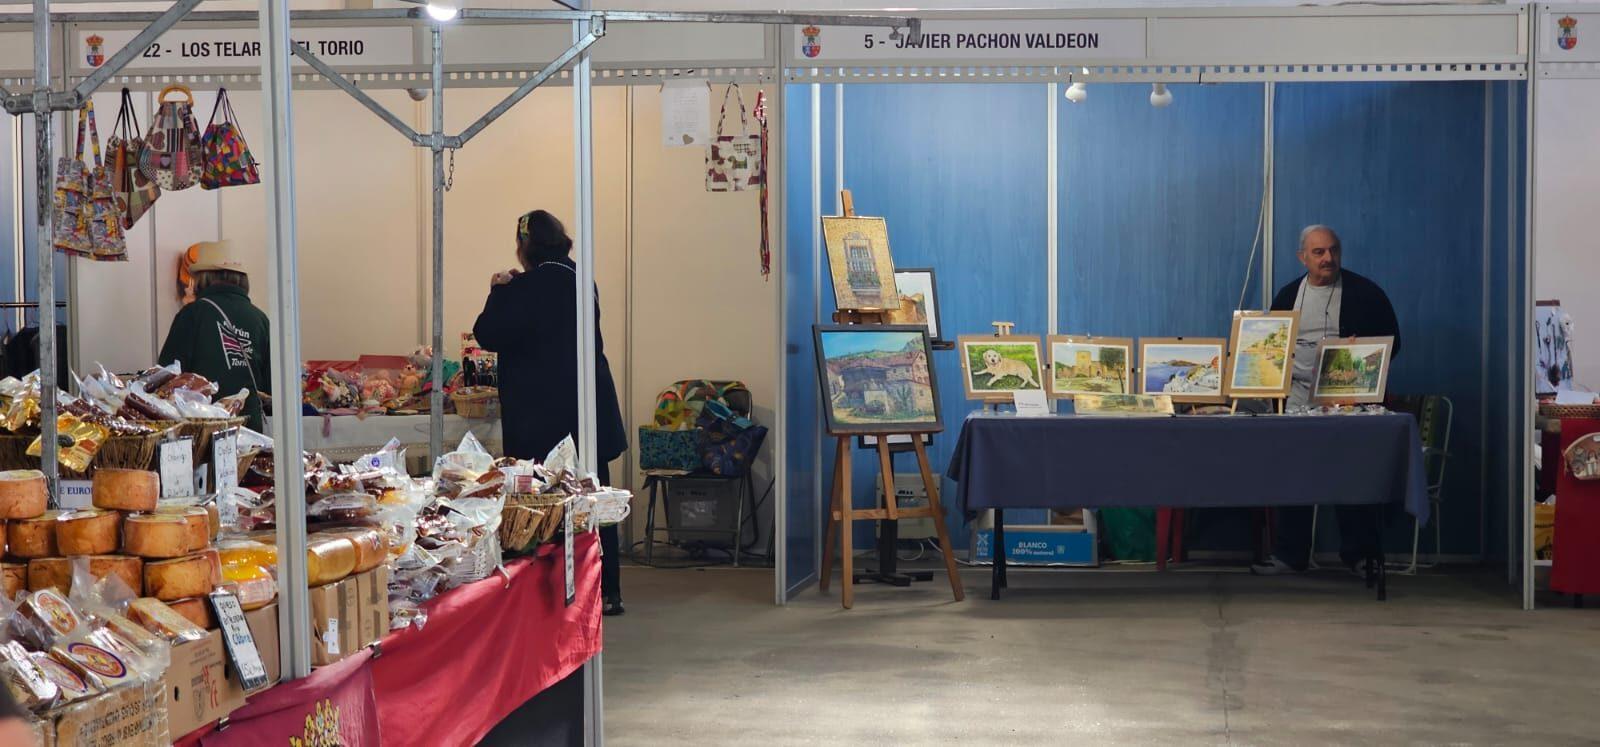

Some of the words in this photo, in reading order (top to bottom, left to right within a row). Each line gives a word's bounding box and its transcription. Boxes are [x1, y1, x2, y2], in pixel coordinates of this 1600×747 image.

[181, 42, 210, 57] LOS
[214, 41, 261, 57] TELAR
[318, 40, 364, 55] TORIO
[864, 34, 874, 49] 5
[956, 33, 1021, 49] PACHON
[1025, 33, 1099, 49] VALDEON
[1018, 541, 1047, 549] BLANCO
